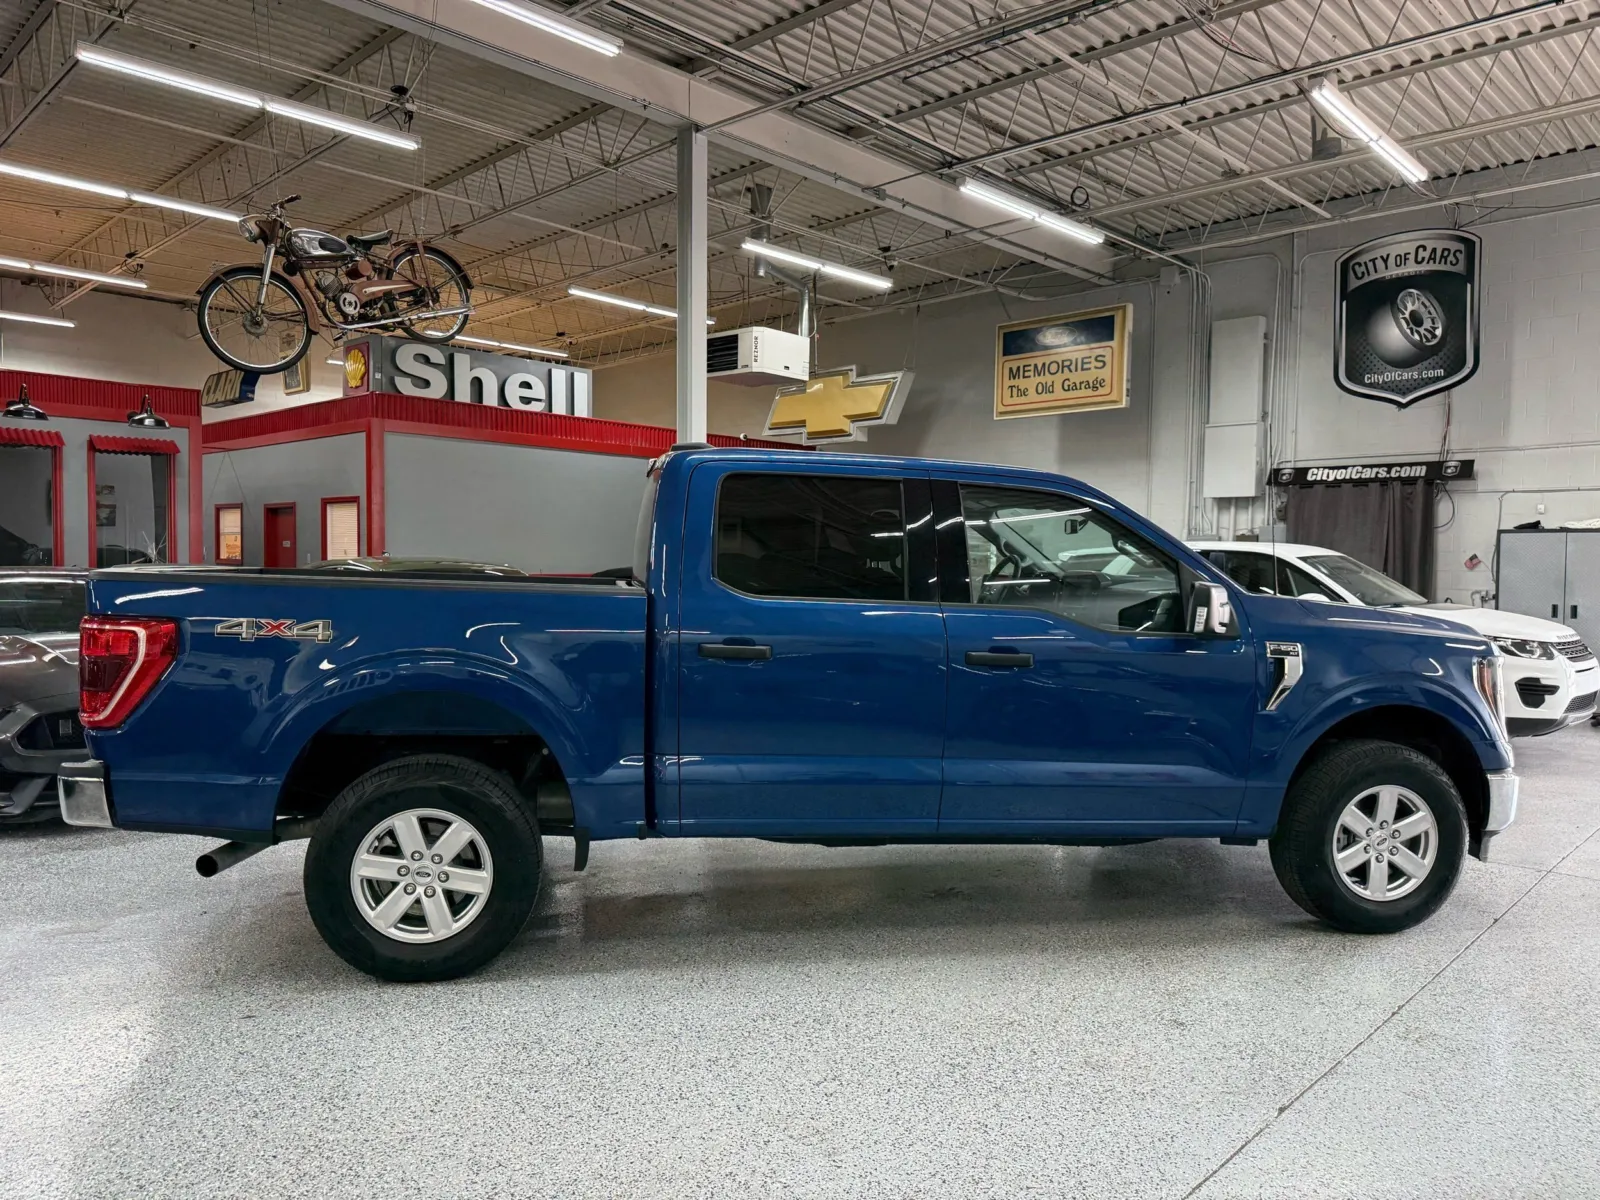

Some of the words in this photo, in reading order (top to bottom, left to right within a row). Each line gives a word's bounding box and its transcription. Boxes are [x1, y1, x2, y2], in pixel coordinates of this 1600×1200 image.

[1351, 253, 1390, 281] CITY
[1394, 252, 1411, 268] OF
[1414, 244, 1463, 267] CARS
[1008, 354, 1107, 381] MEMORIES
[1364, 368, 1445, 384] CityOfCars.com
[394, 343, 588, 418] Shell
[1007, 385, 1029, 398] The
[1035, 381, 1055, 395] Old
[1061, 376, 1106, 392] Garage
[1306, 465, 1427, 482] CityofCars.com
[1270, 644, 1298, 652] F-150
